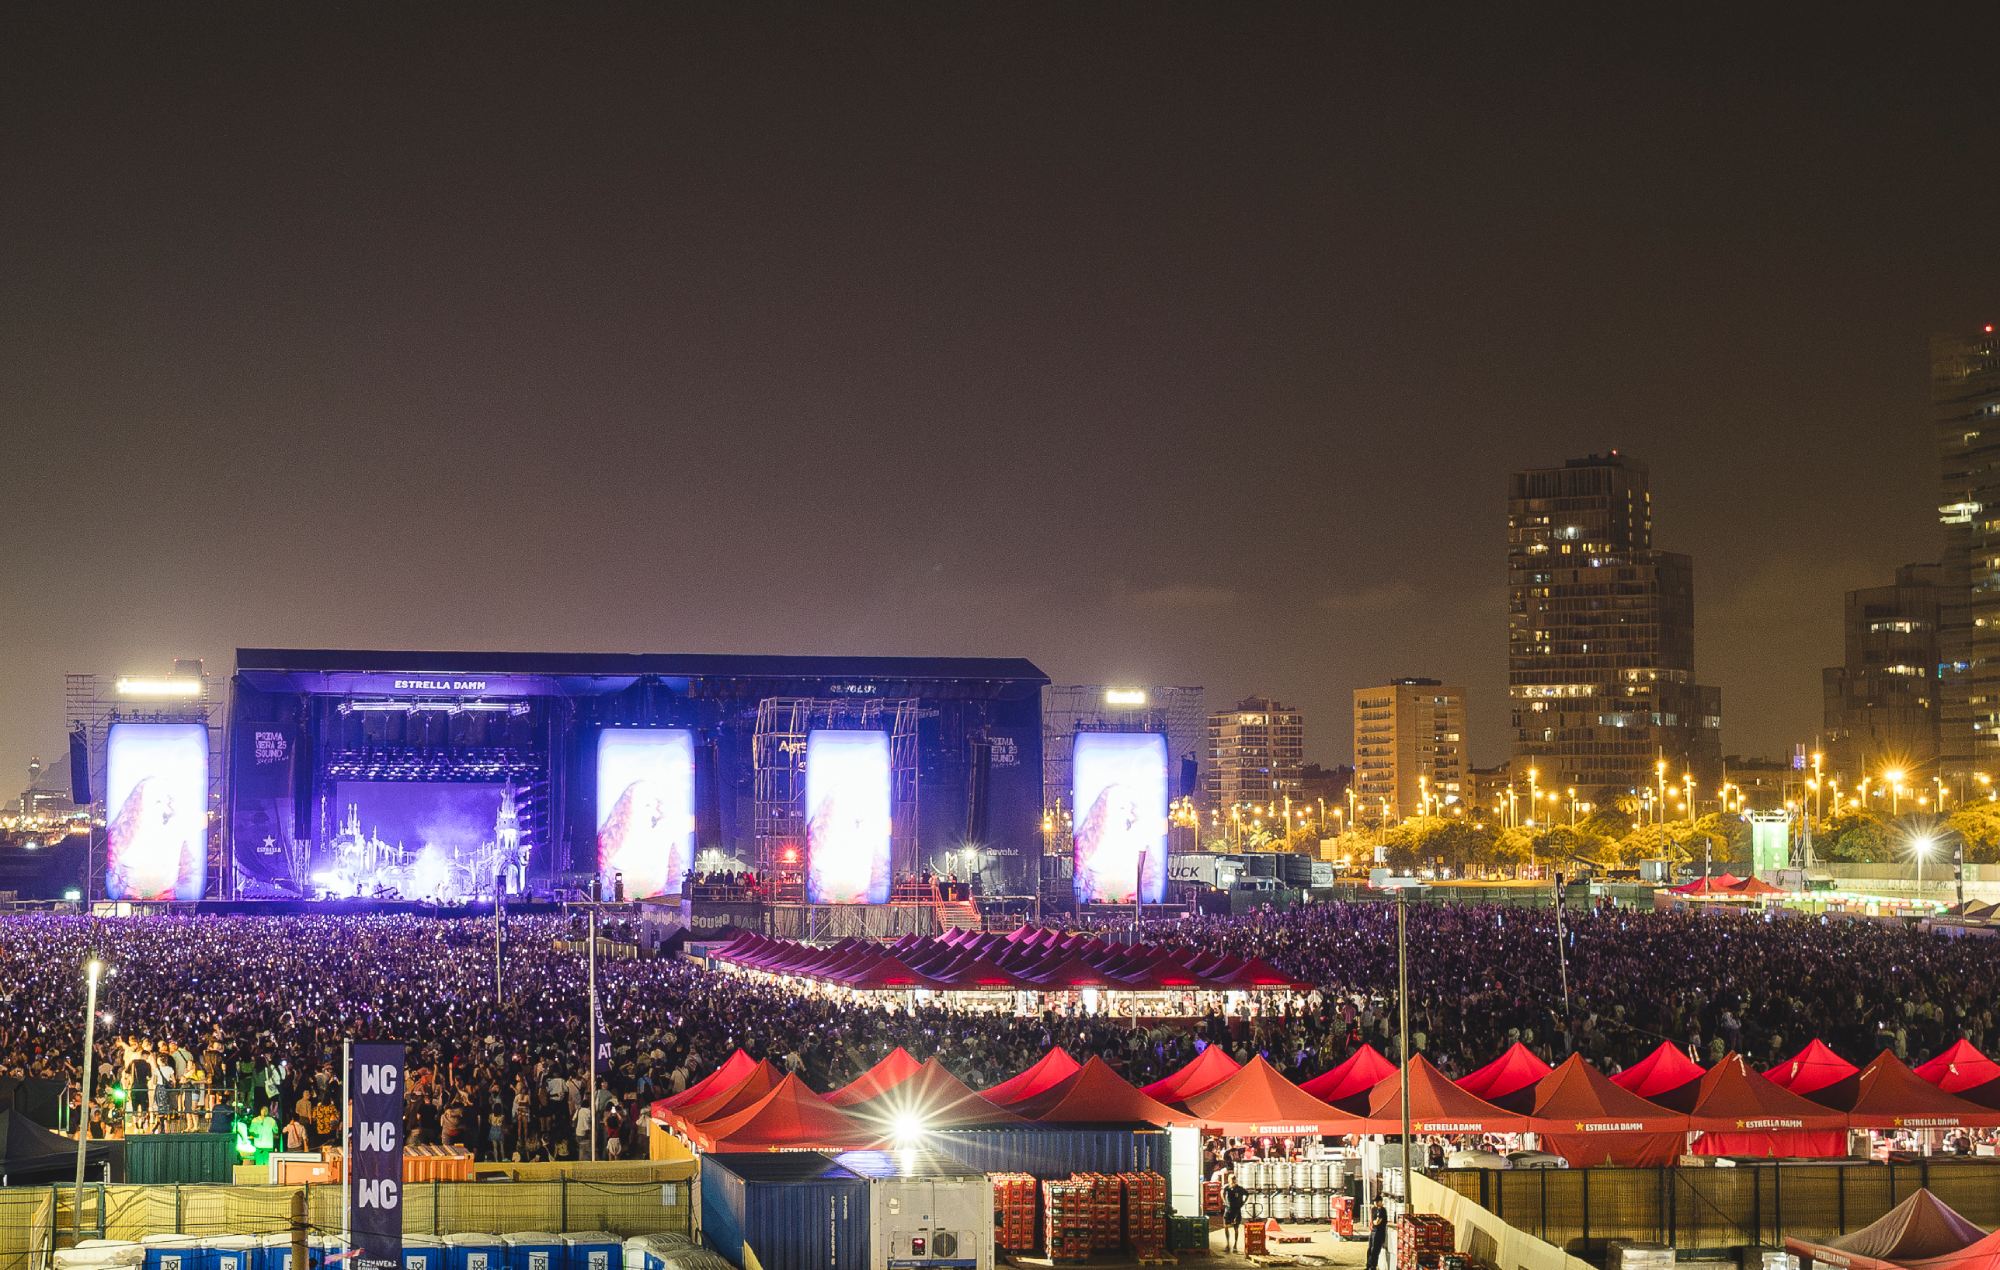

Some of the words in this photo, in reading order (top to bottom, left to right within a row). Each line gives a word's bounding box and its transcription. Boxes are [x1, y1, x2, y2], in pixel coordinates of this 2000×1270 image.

[394, 680, 450, 689] ESTRELLA
[454, 681, 486, 690] DAMM
[256, 749, 283, 758] SOUND
[987, 848, 1019, 856] Revolut
[1168, 866, 1200, 878] UCK
[692, 914, 730, 928] SOUND
[361, 1064, 398, 1094] WC
[1746, 1120, 1779, 1128] ESTRELLA
[360, 1122, 396, 1152] WC
[358, 1178, 398, 1210] WC
